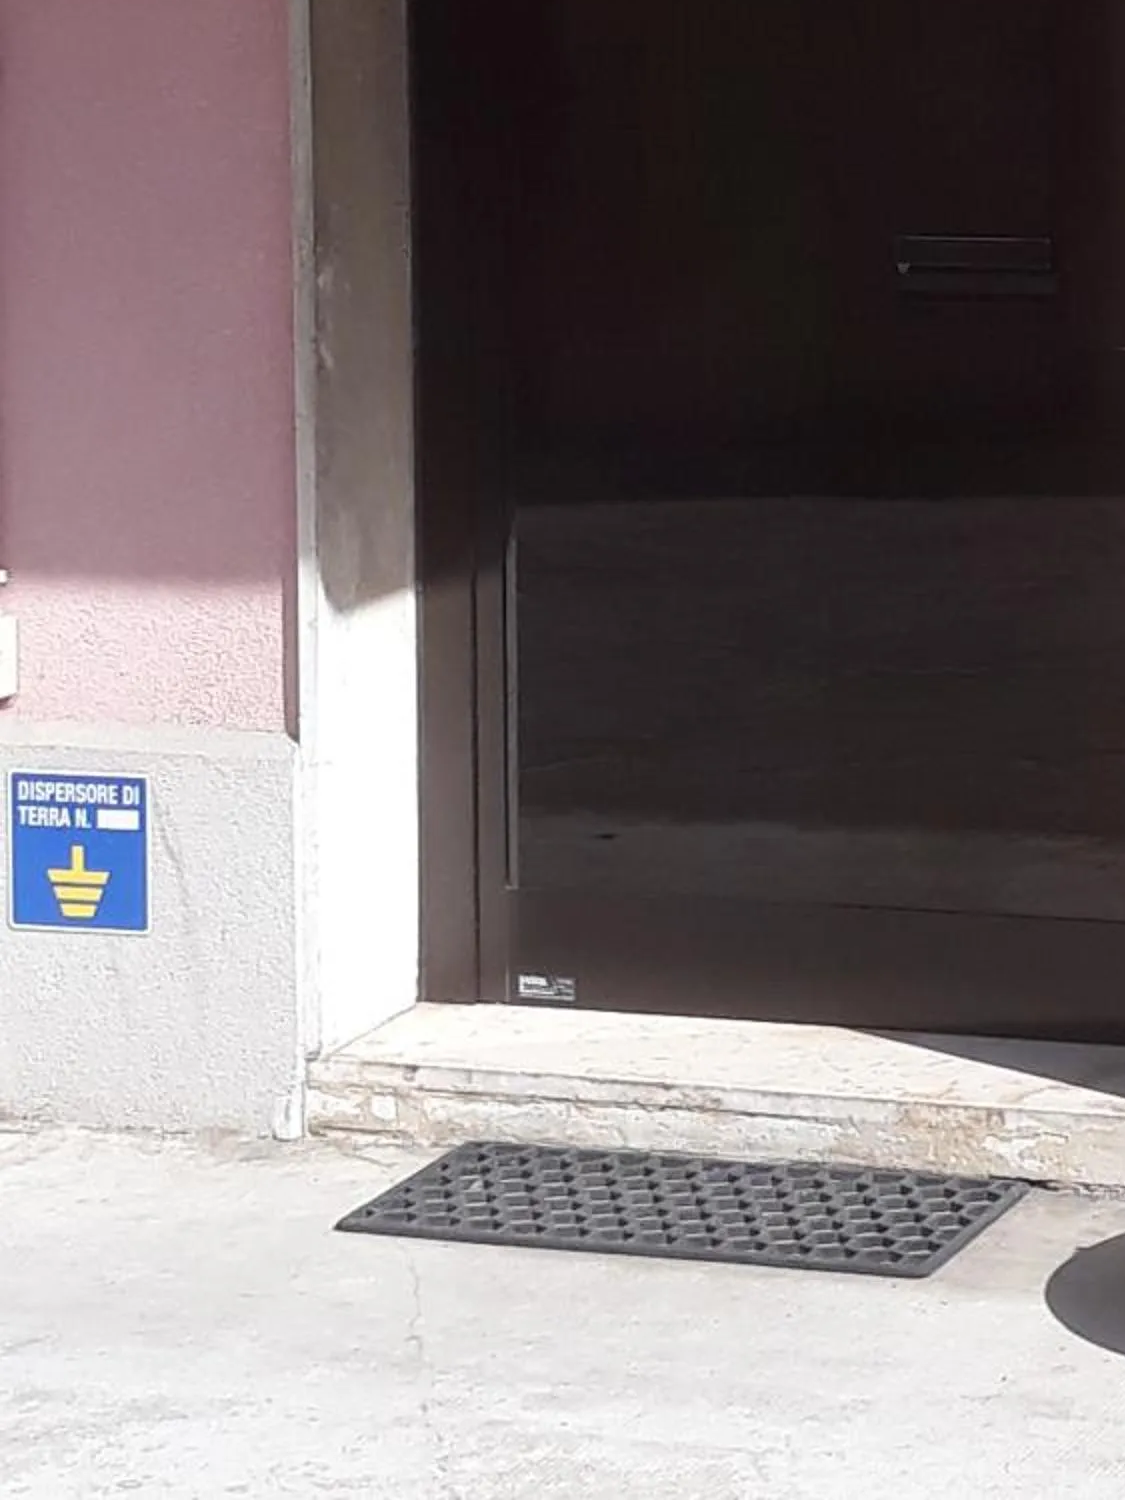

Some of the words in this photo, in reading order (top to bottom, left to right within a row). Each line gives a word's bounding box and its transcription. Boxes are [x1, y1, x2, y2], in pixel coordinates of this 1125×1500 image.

[17, 780, 119, 804] DISPERSORE
[122, 786, 140, 805] DI
[17, 805, 71, 827] TERRA
[75, 808, 92, 828] N.
